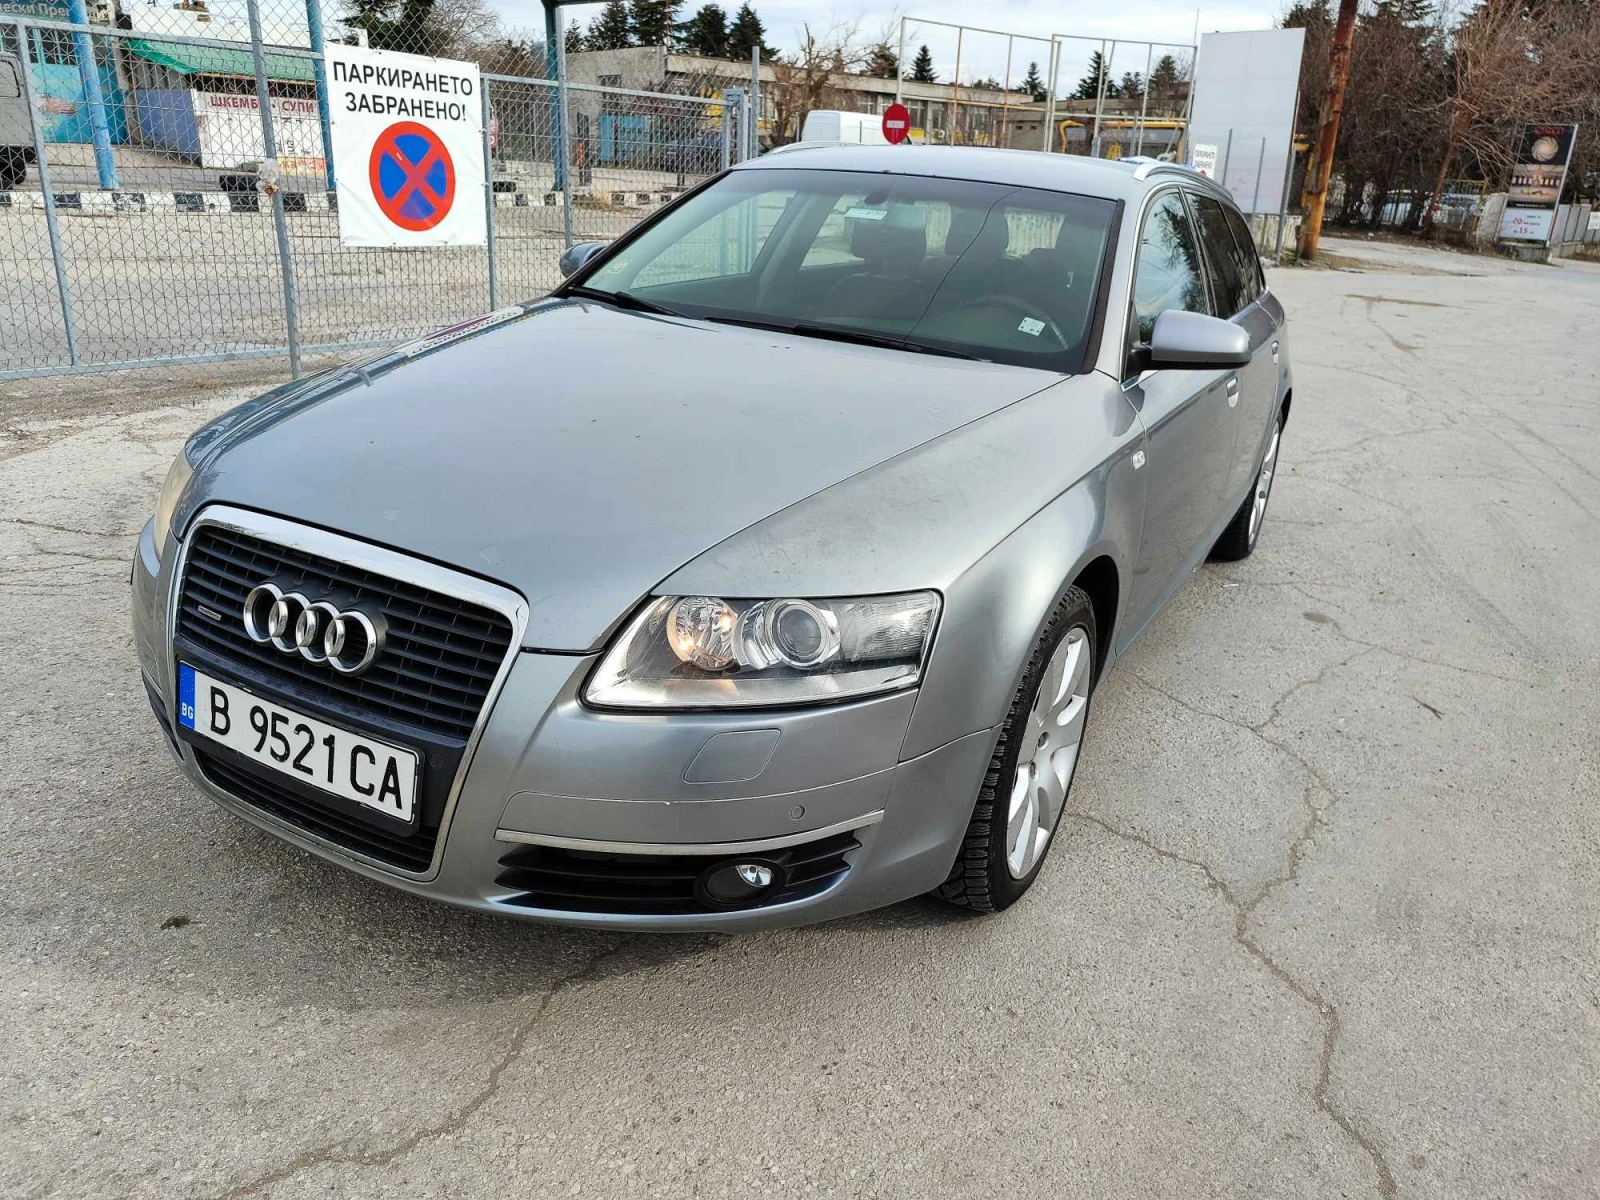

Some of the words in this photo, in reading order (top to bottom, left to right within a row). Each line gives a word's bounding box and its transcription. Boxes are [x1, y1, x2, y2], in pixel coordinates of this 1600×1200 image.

[333, 61, 473, 96] ПАРКИРАНЕТО
[210, 96, 259, 109] ШКЕМБ
[345, 92, 466, 121] ЗАБРАНЕНО!
[181, 702, 194, 719] BG
[210, 686, 231, 735] B
[249, 705, 336, 784] 9521
[350, 744, 402, 810] CA
